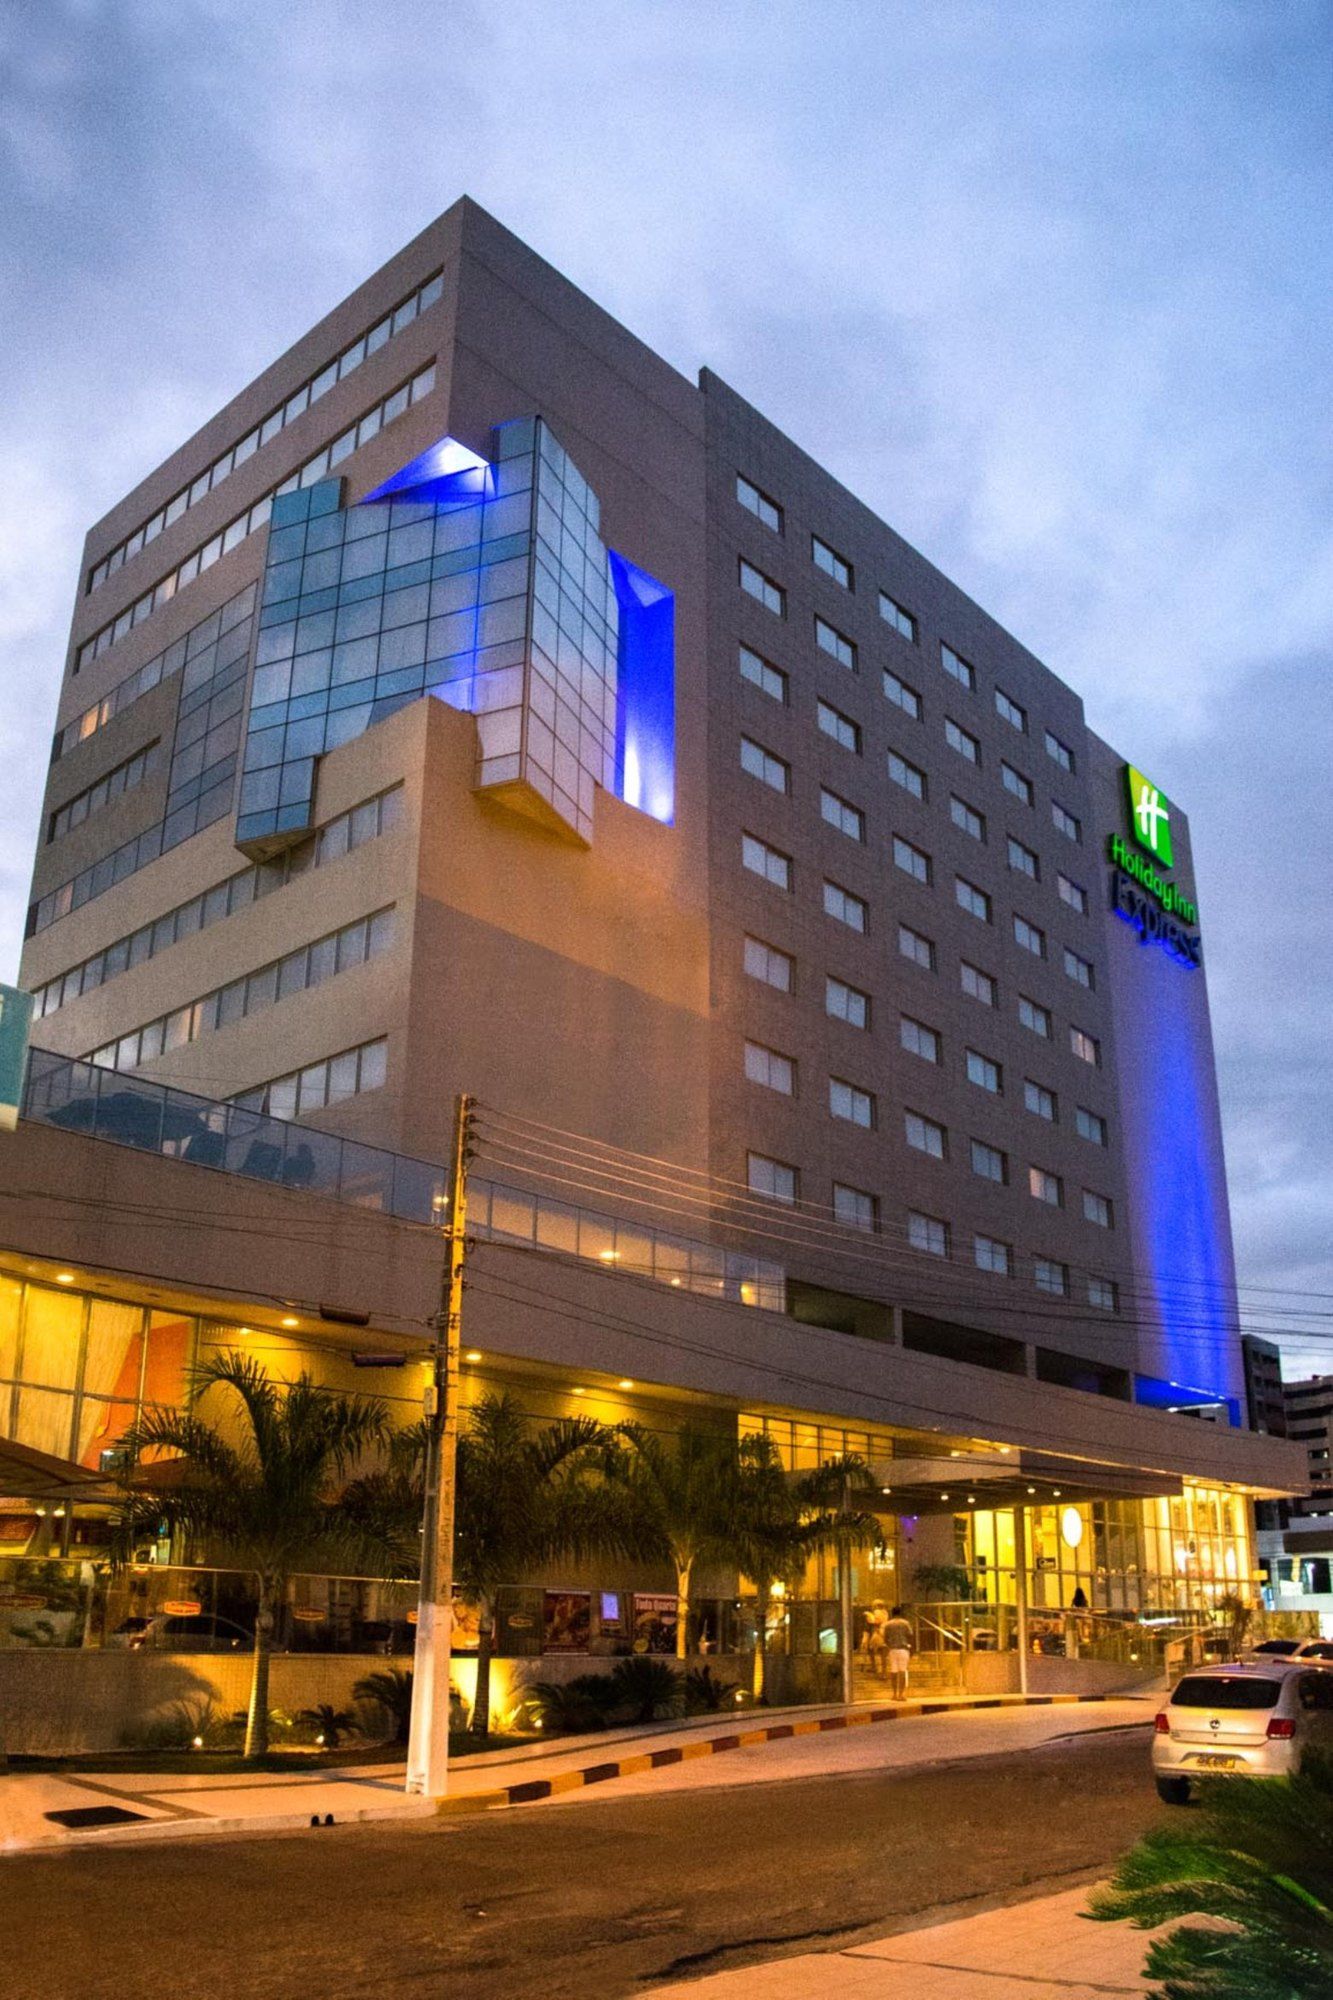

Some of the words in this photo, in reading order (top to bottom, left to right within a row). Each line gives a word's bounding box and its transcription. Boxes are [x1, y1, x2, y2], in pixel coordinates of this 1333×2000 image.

[1111, 869, 1201, 967] Express
[1112, 834, 1173, 912] Holiday
[1174, 883, 1197, 925] Inn
